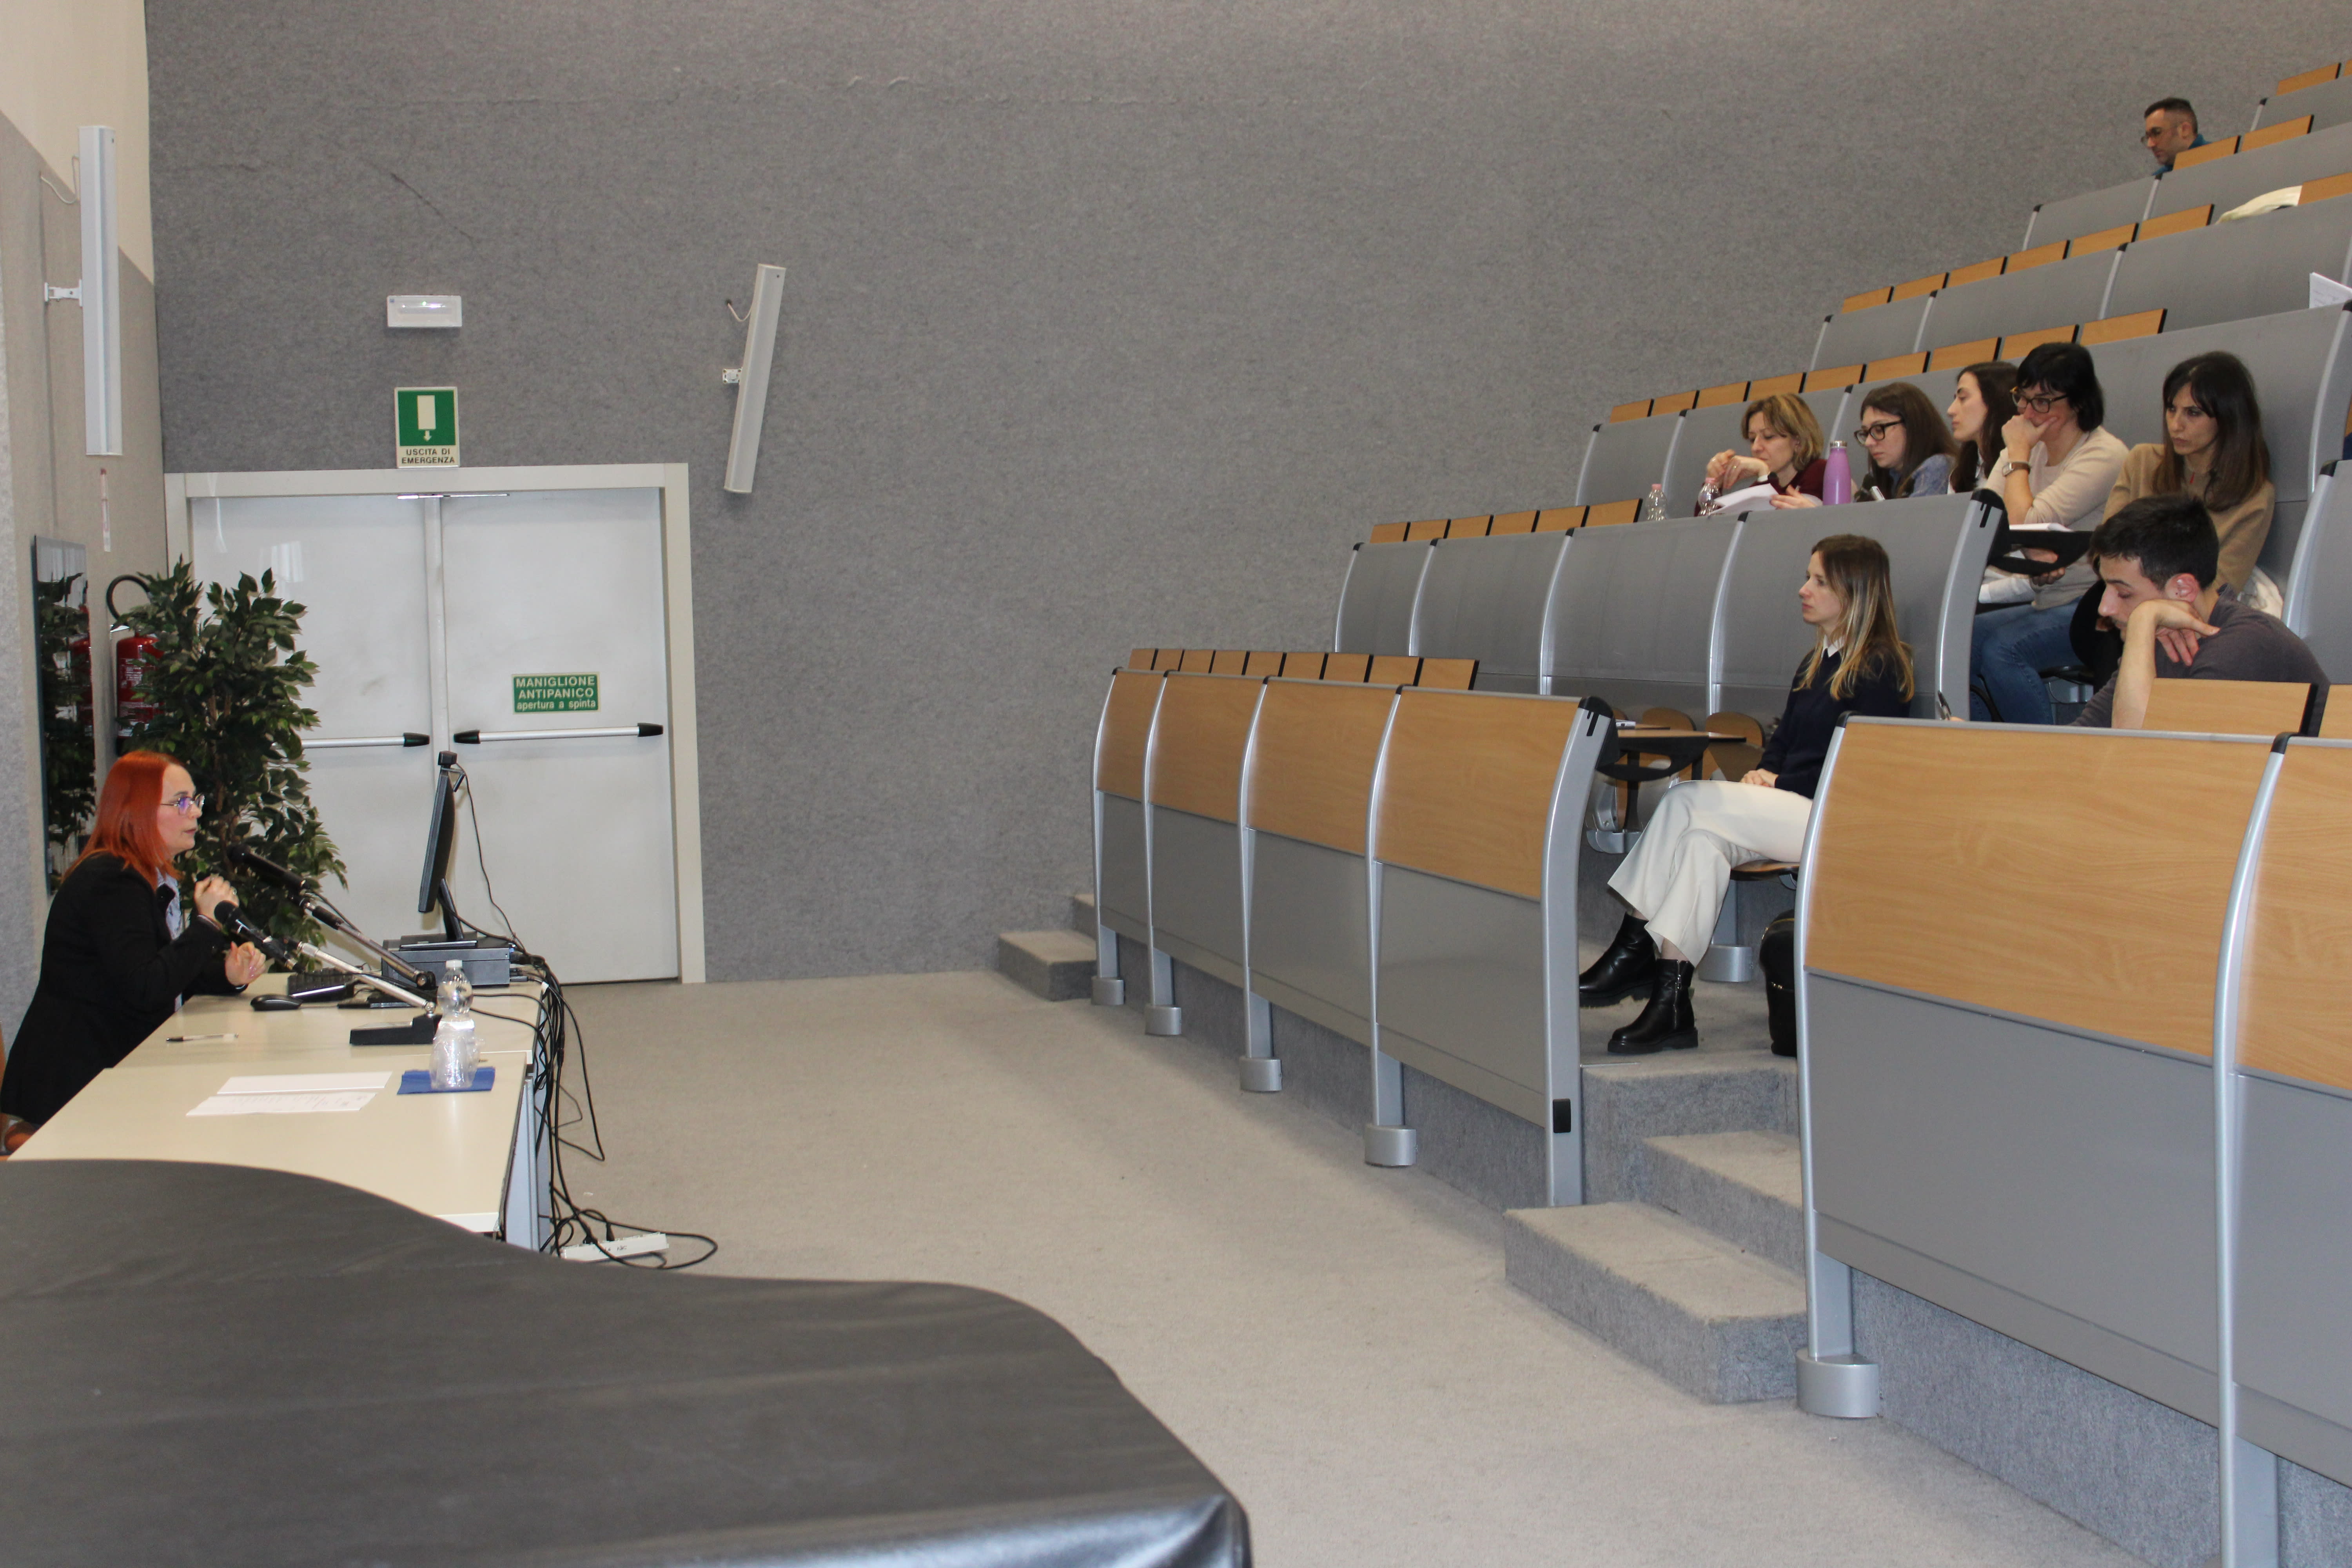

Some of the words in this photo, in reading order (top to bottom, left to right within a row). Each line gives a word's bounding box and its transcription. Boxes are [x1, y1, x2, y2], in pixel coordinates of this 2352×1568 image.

[515, 676, 595, 688] MANIGLIONE
[519, 688, 594, 700] ANTIPANICO
[517, 700, 554, 711] apertura
[559, 701, 564, 709] a
[569, 699, 596, 710] spinta
